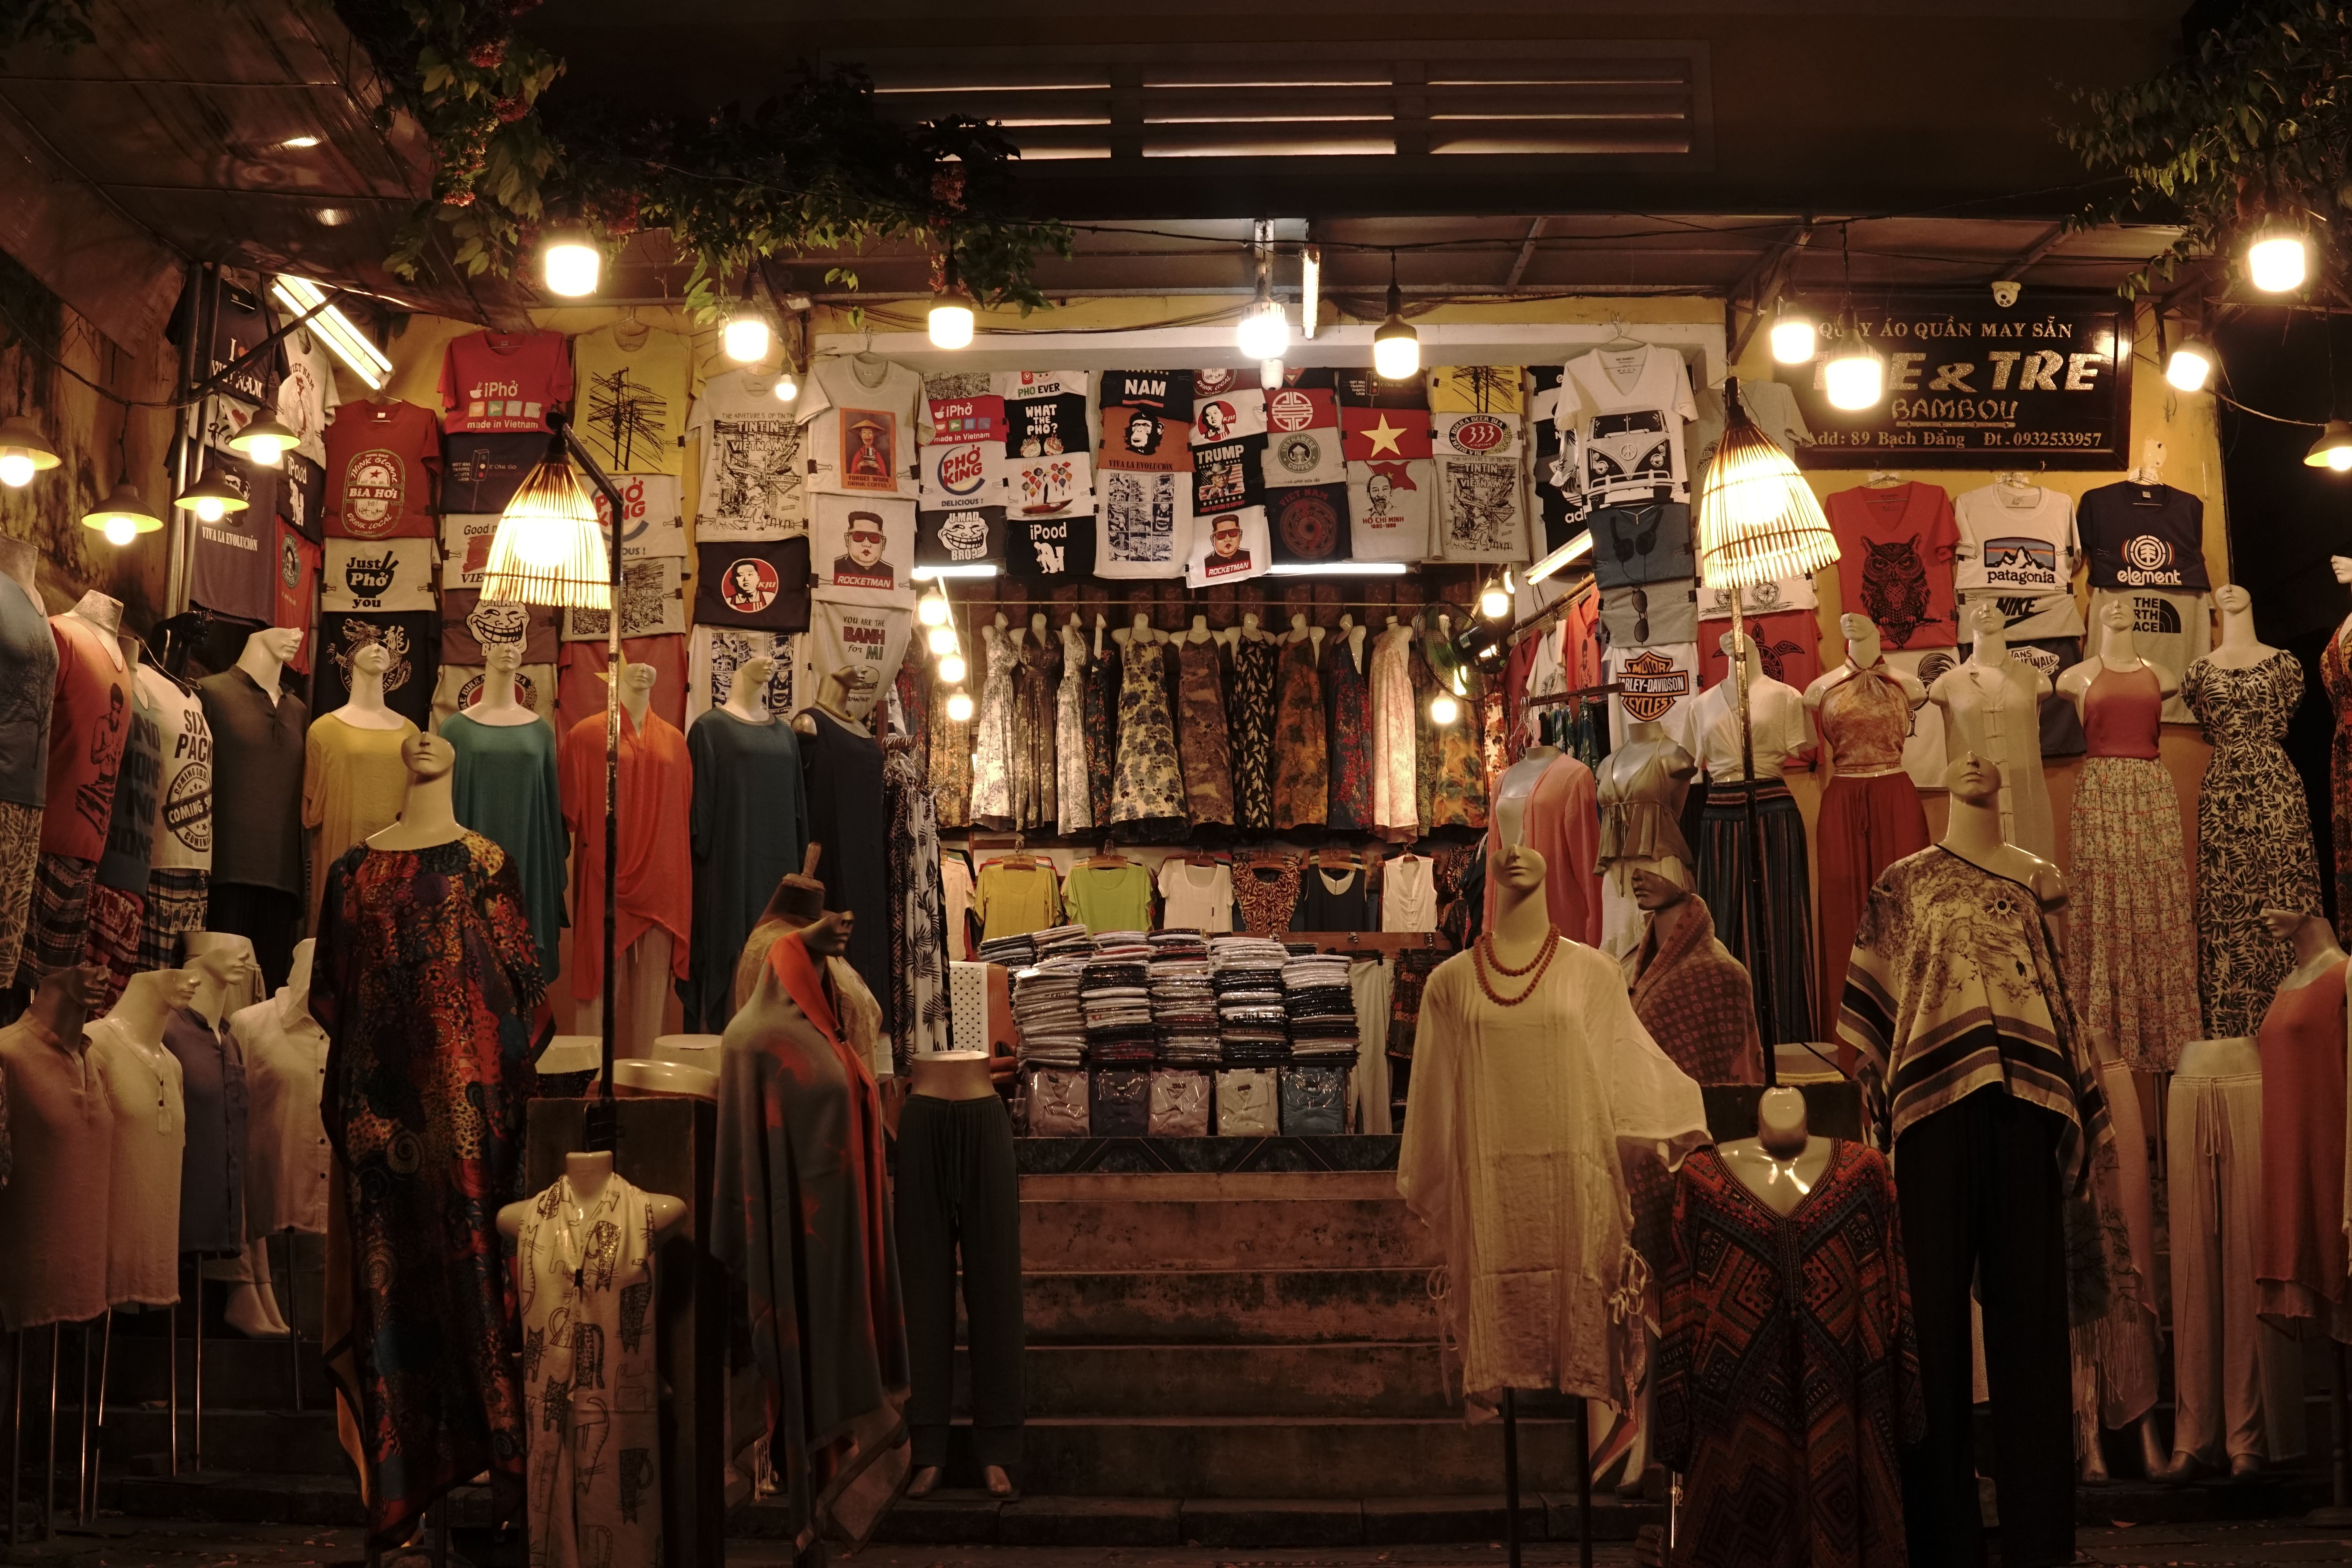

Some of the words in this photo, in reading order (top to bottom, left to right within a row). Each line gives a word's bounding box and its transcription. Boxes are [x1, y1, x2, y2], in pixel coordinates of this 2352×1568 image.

[1819, 322, 1873, 339] QUY
[1880, 318, 1908, 337] ÁO
[1914, 316, 1972, 340] QUẦN
[1980, 323, 2025, 337] MAY
[2032, 315, 2073, 338] SẴN
[1928, 363, 1978, 392] &
[1988, 350, 2102, 390] TRE
[236, 376, 262, 398] NAM
[484, 380, 518, 397] iPhở
[1018, 387, 1036, 397] PHO
[1038, 383, 1060, 394] EVER
[1124, 379, 1167, 397] NAM
[1197, 380, 1213, 391] DRINK
[1214, 375, 1232, 390] LOCAL
[946, 402, 973, 417] iPhở
[1025, 404, 1057, 418] WHAT
[1891, 398, 2018, 419] BAMBOU
[467, 420, 490, 428] made
[494, 420, 501, 428] in
[504, 419, 538, 428] Vietnam
[737, 421, 780, 433] TINTIN
[1033, 416, 1051, 425] THE
[1451, 418, 1470, 434] BIRRA
[1490, 417, 1503, 427] BIA
[1026, 423, 1058, 436] PHO?
[1466, 425, 1494, 444] 333
[731, 441, 784, 451] VIETNAM
[1281, 436, 1317, 452] VIETNAMESE
[1450, 436, 1468, 454] BIERE
[1851, 431, 1870, 445] 89
[1878, 431, 1916, 448] Bạch
[1922, 428, 1965, 448] Đằng
[1196, 445, 1245, 465] TRUMP
[287, 454, 307, 485] iPood
[350, 457, 372, 479] THINK
[375, 457, 397, 483] GLOBAL
[1109, 459, 1125, 468] VIVA
[1126, 460, 1135, 469] LA
[1136, 461, 1173, 471] EVOLUCIÓN
[1288, 461, 1314, 470] COFFEE
[1465, 463, 1498, 474] TINTIN
[943, 462, 982, 488] KING
[1460, 479, 1501, 488] VIETNAM
[942, 499, 979, 507] DELICIOUS
[347, 513, 367, 529] DRINK
[368, 513, 392, 529] LOCAL
[957, 511, 979, 522] MAD
[464, 523, 490, 535] Good
[1030, 521, 1067, 540] iPood
[202, 526, 217, 541] VIVA
[218, 530, 225, 544] LA
[226, 532, 258, 552] EVOLUCIÓN
[951, 548, 978, 561] BRO?
[346, 557, 381, 569] Just
[1208, 561, 1249, 576] ROCKETMAN
[350, 572, 389, 586] Phở
[837, 575, 891, 588] ROCKETMAN
[1987, 570, 2056, 585] patagonia
[2117, 566, 2182, 586] element
[352, 599, 381, 608] you
[1996, 597, 2038, 616] NIKE
[2133, 597, 2159, 608] THE
[2132, 621, 2158, 632] ACE
[848, 645, 862, 653] for
[866, 646, 884, 660] MI
[1632, 657, 1666, 674] MOTOR
[1629, 697, 1668, 717] CYCLES
[183, 709, 207, 737] SIX
[174, 733, 212, 766] PACK
[174, 768, 196, 795] COMING
[168, 799, 203, 824] COMING
